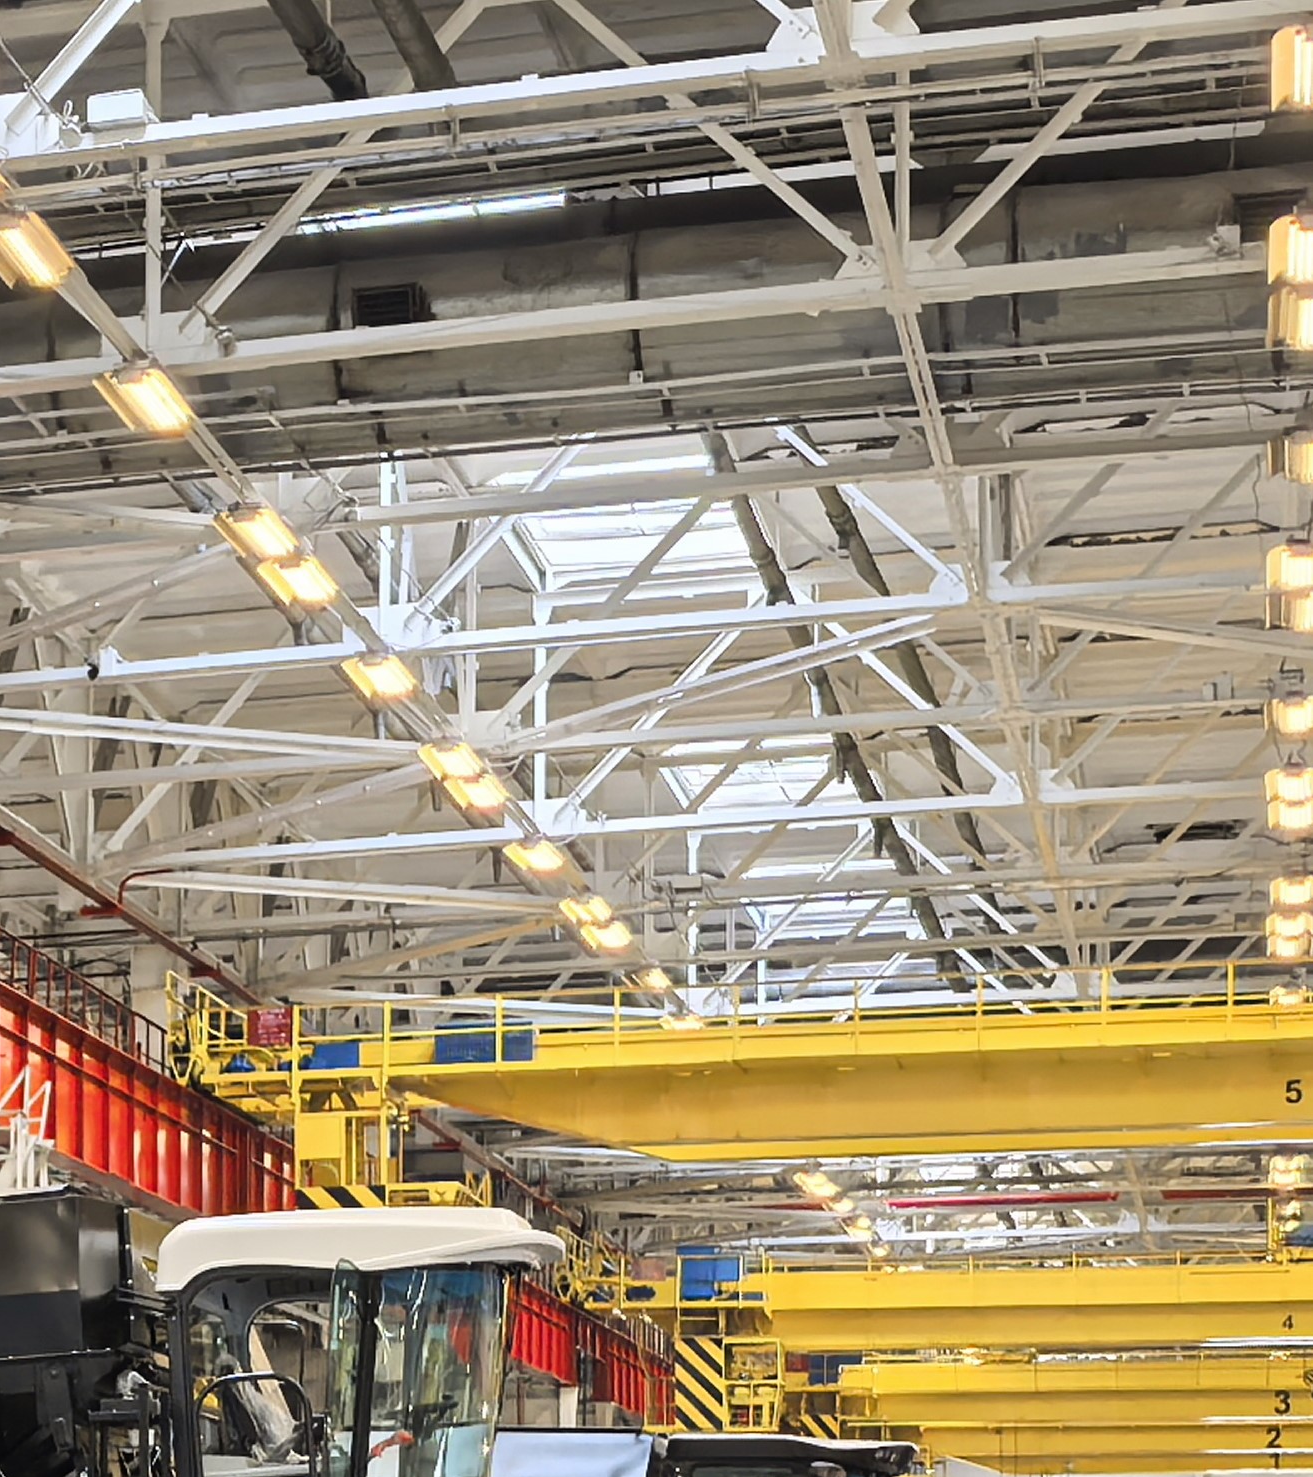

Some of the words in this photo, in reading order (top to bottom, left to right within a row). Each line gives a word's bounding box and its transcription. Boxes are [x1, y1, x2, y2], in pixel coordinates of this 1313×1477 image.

[1285, 1079, 1302, 1104] 5
[1281, 1314, 1294, 1330] 4
[1274, 1389, 1291, 1415] 3
[1266, 1426, 1282, 1448] 2
[1268, 1453, 1281, 1469] 1
